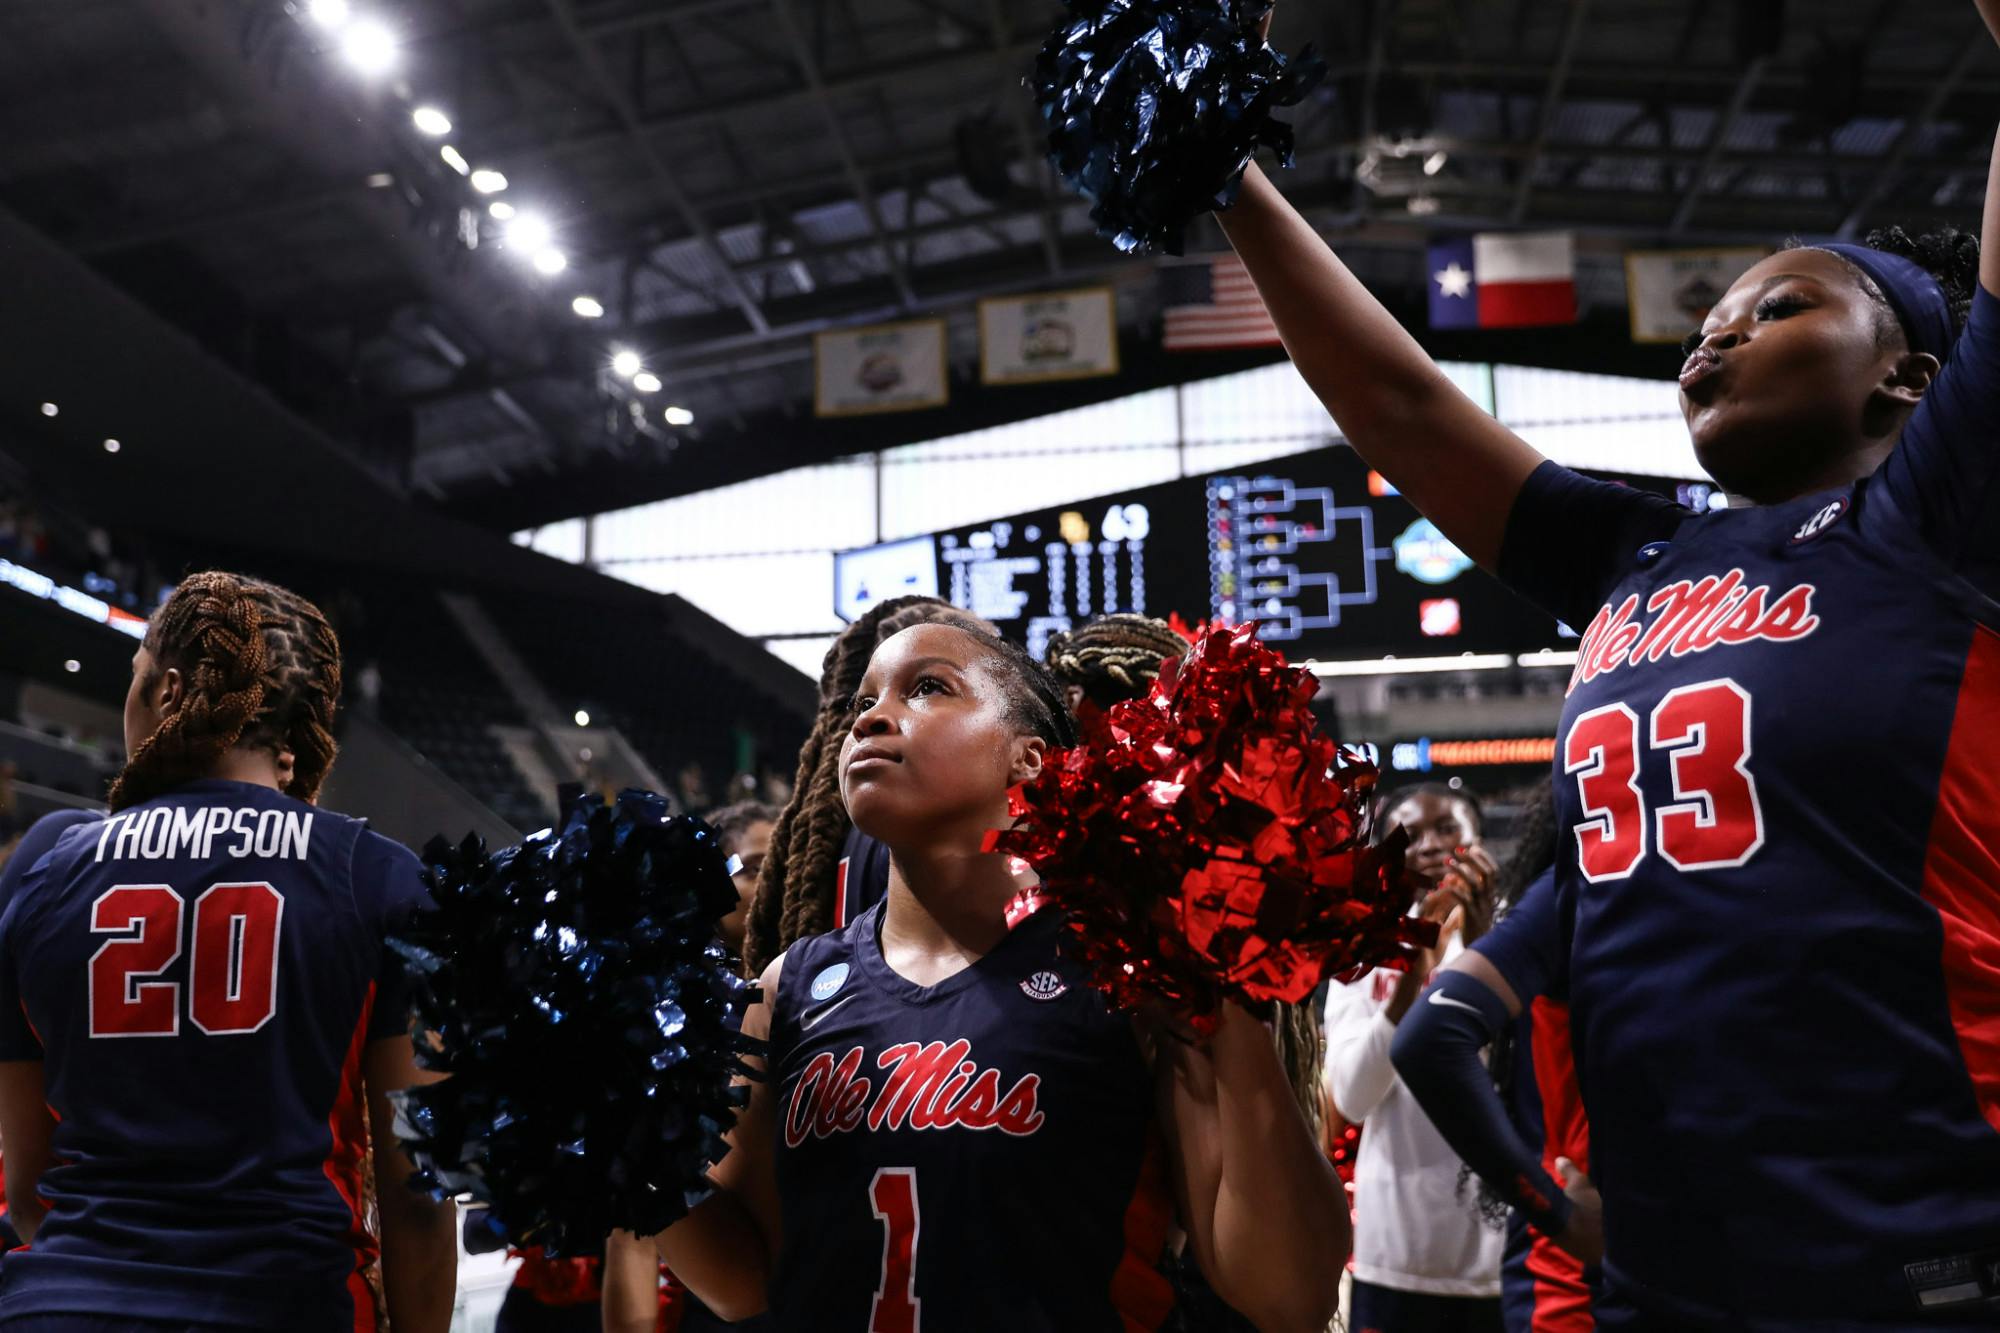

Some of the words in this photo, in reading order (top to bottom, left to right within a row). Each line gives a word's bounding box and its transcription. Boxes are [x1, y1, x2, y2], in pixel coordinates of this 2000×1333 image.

[1565, 593, 1642, 699] Ole
[1629, 568, 1820, 666] Miss
[95, 806, 314, 862] THOMPSON
[1564, 677, 1765, 885] 33
[88, 881, 285, 1039] 20
[1030, 971, 1059, 992] SEC
[785, 1046, 871, 1148] Ole
[867, 1038, 1045, 1136] Miss
[868, 1166, 920, 1333] 1
